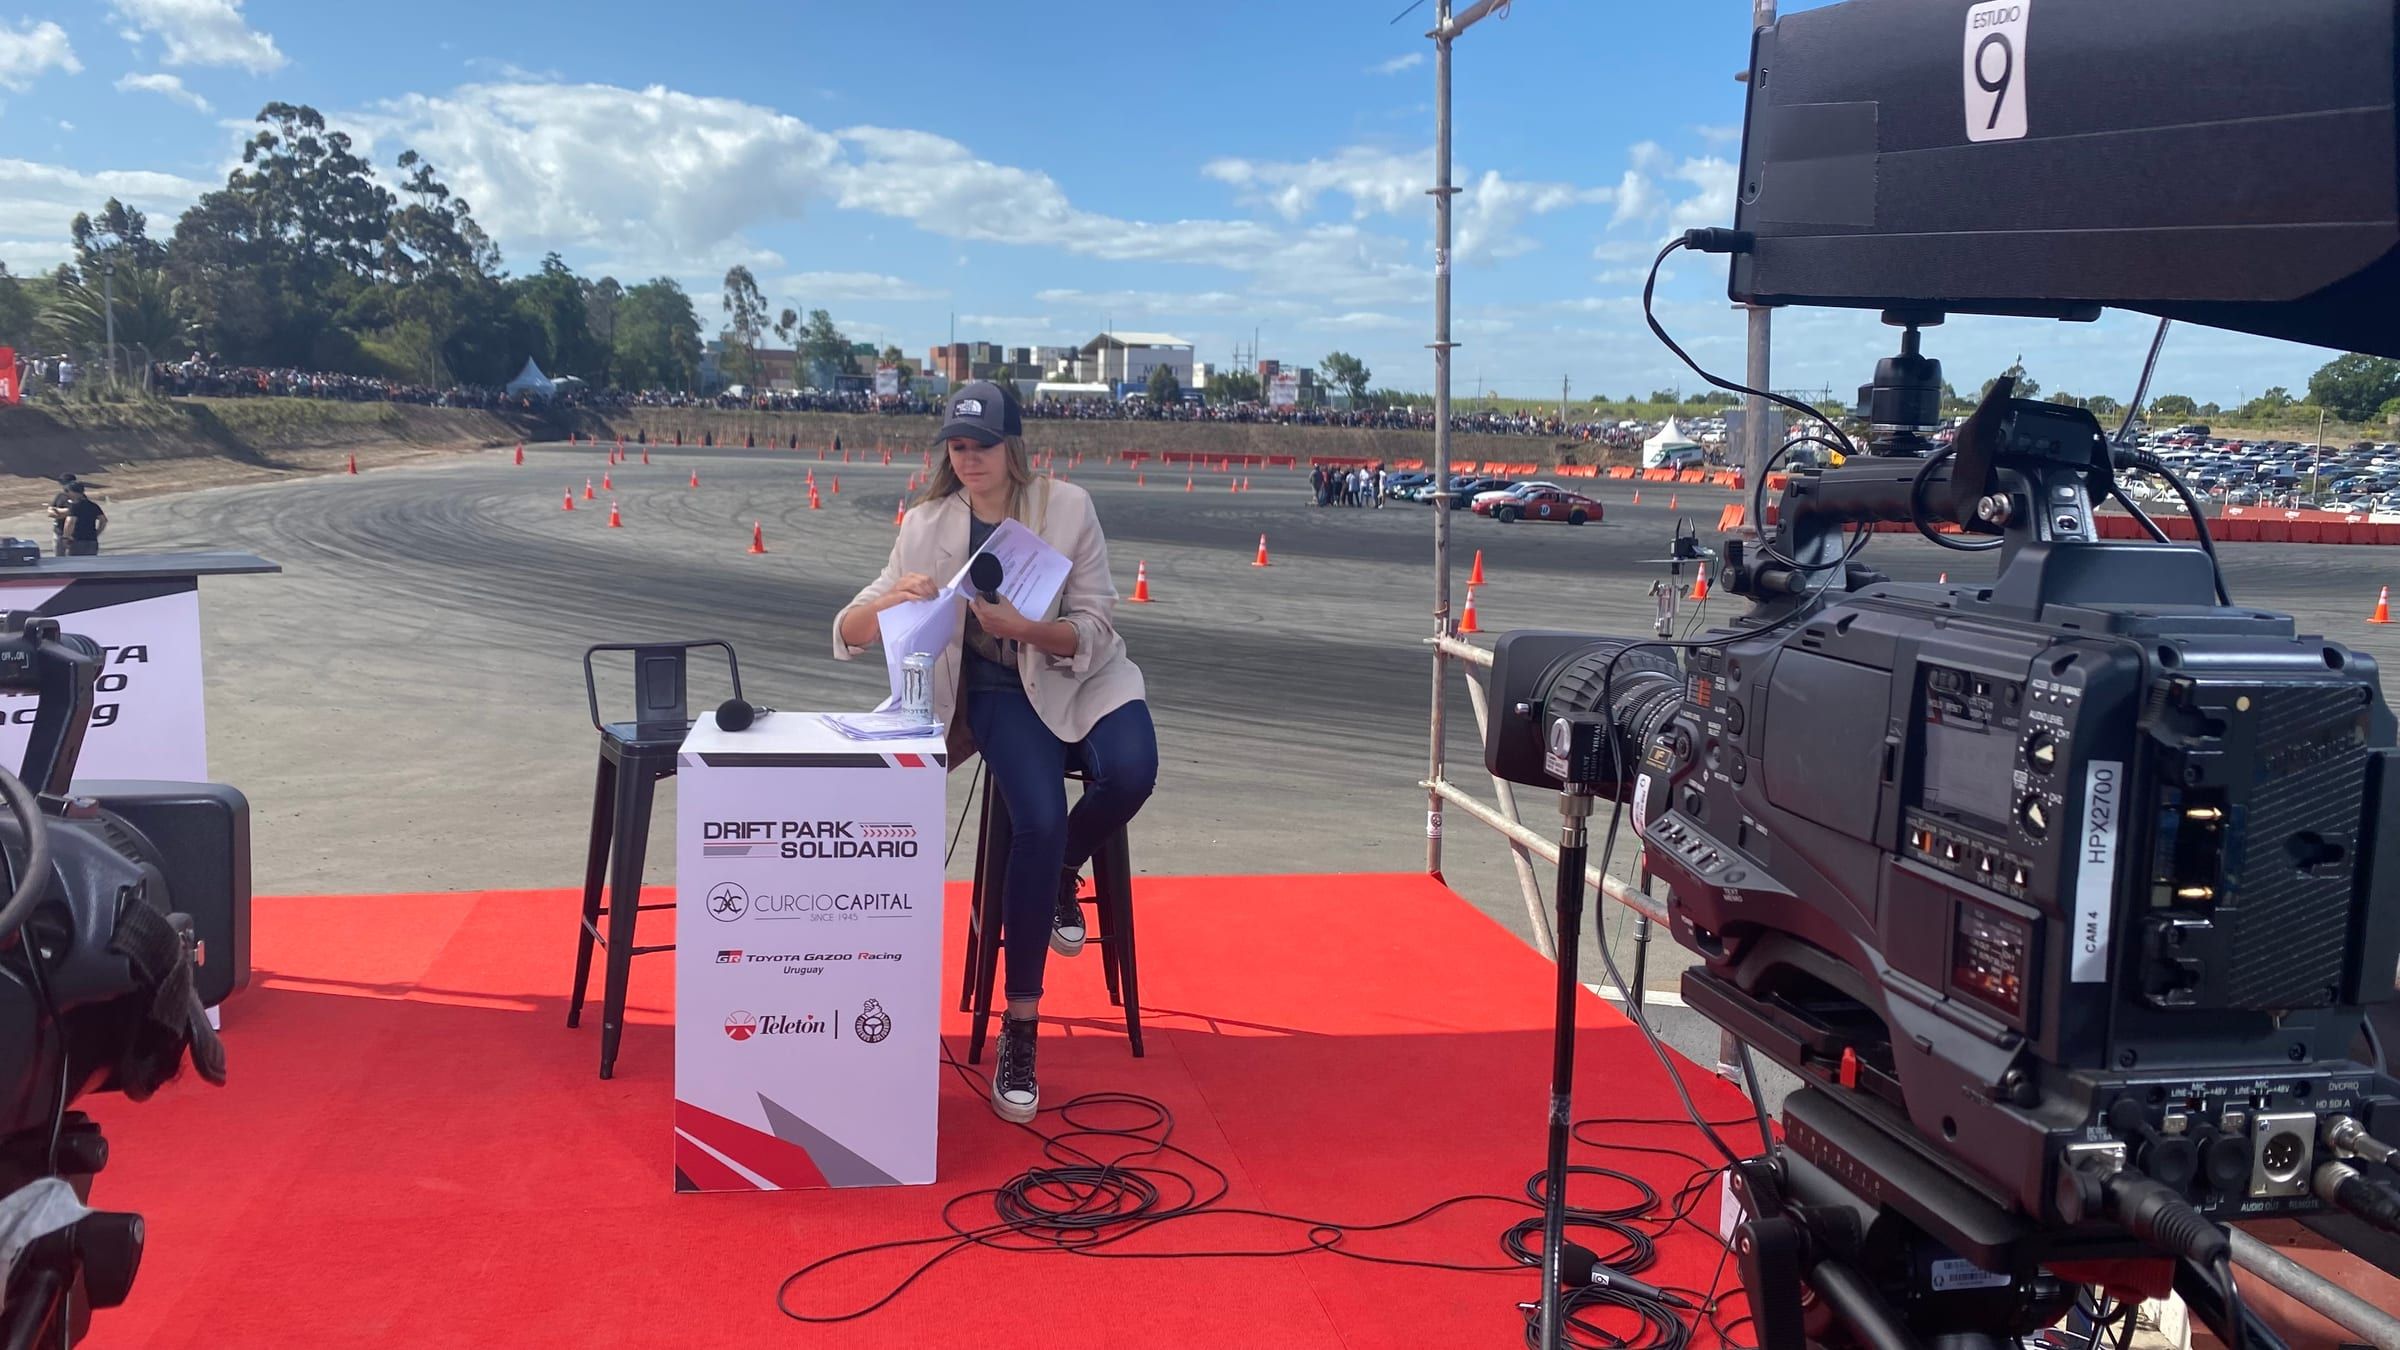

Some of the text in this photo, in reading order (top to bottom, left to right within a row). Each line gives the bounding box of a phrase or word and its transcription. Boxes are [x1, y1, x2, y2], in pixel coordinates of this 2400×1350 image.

[1973, 5, 2020, 29] ESTUDIO
[1975, 32, 2013, 130] 9
[2088, 769, 2114, 864] HPX2700
[704, 821, 854, 839] DRIFT PARK
[781, 840, 918, 859] SOLIDARIO
[754, 893, 913, 912] CURCIOCAPITAL
[809, 912, 859, 922] SINCE 1945
[2085, 911, 2098, 953] CAM 4
[746, 954, 800, 963] TOYOTA
[804, 953, 853, 961] GAZOO
[857, 952, 903, 962] Racing
[783, 966, 824, 976] Uruguay
[2171, 1088, 2187, 1098] LINE
[2328, 1082, 2360, 1091] DVCPRO
[2315, 1098, 2352, 1109] HD SDI A
[2241, 1202, 2265, 1212] AUDIO
